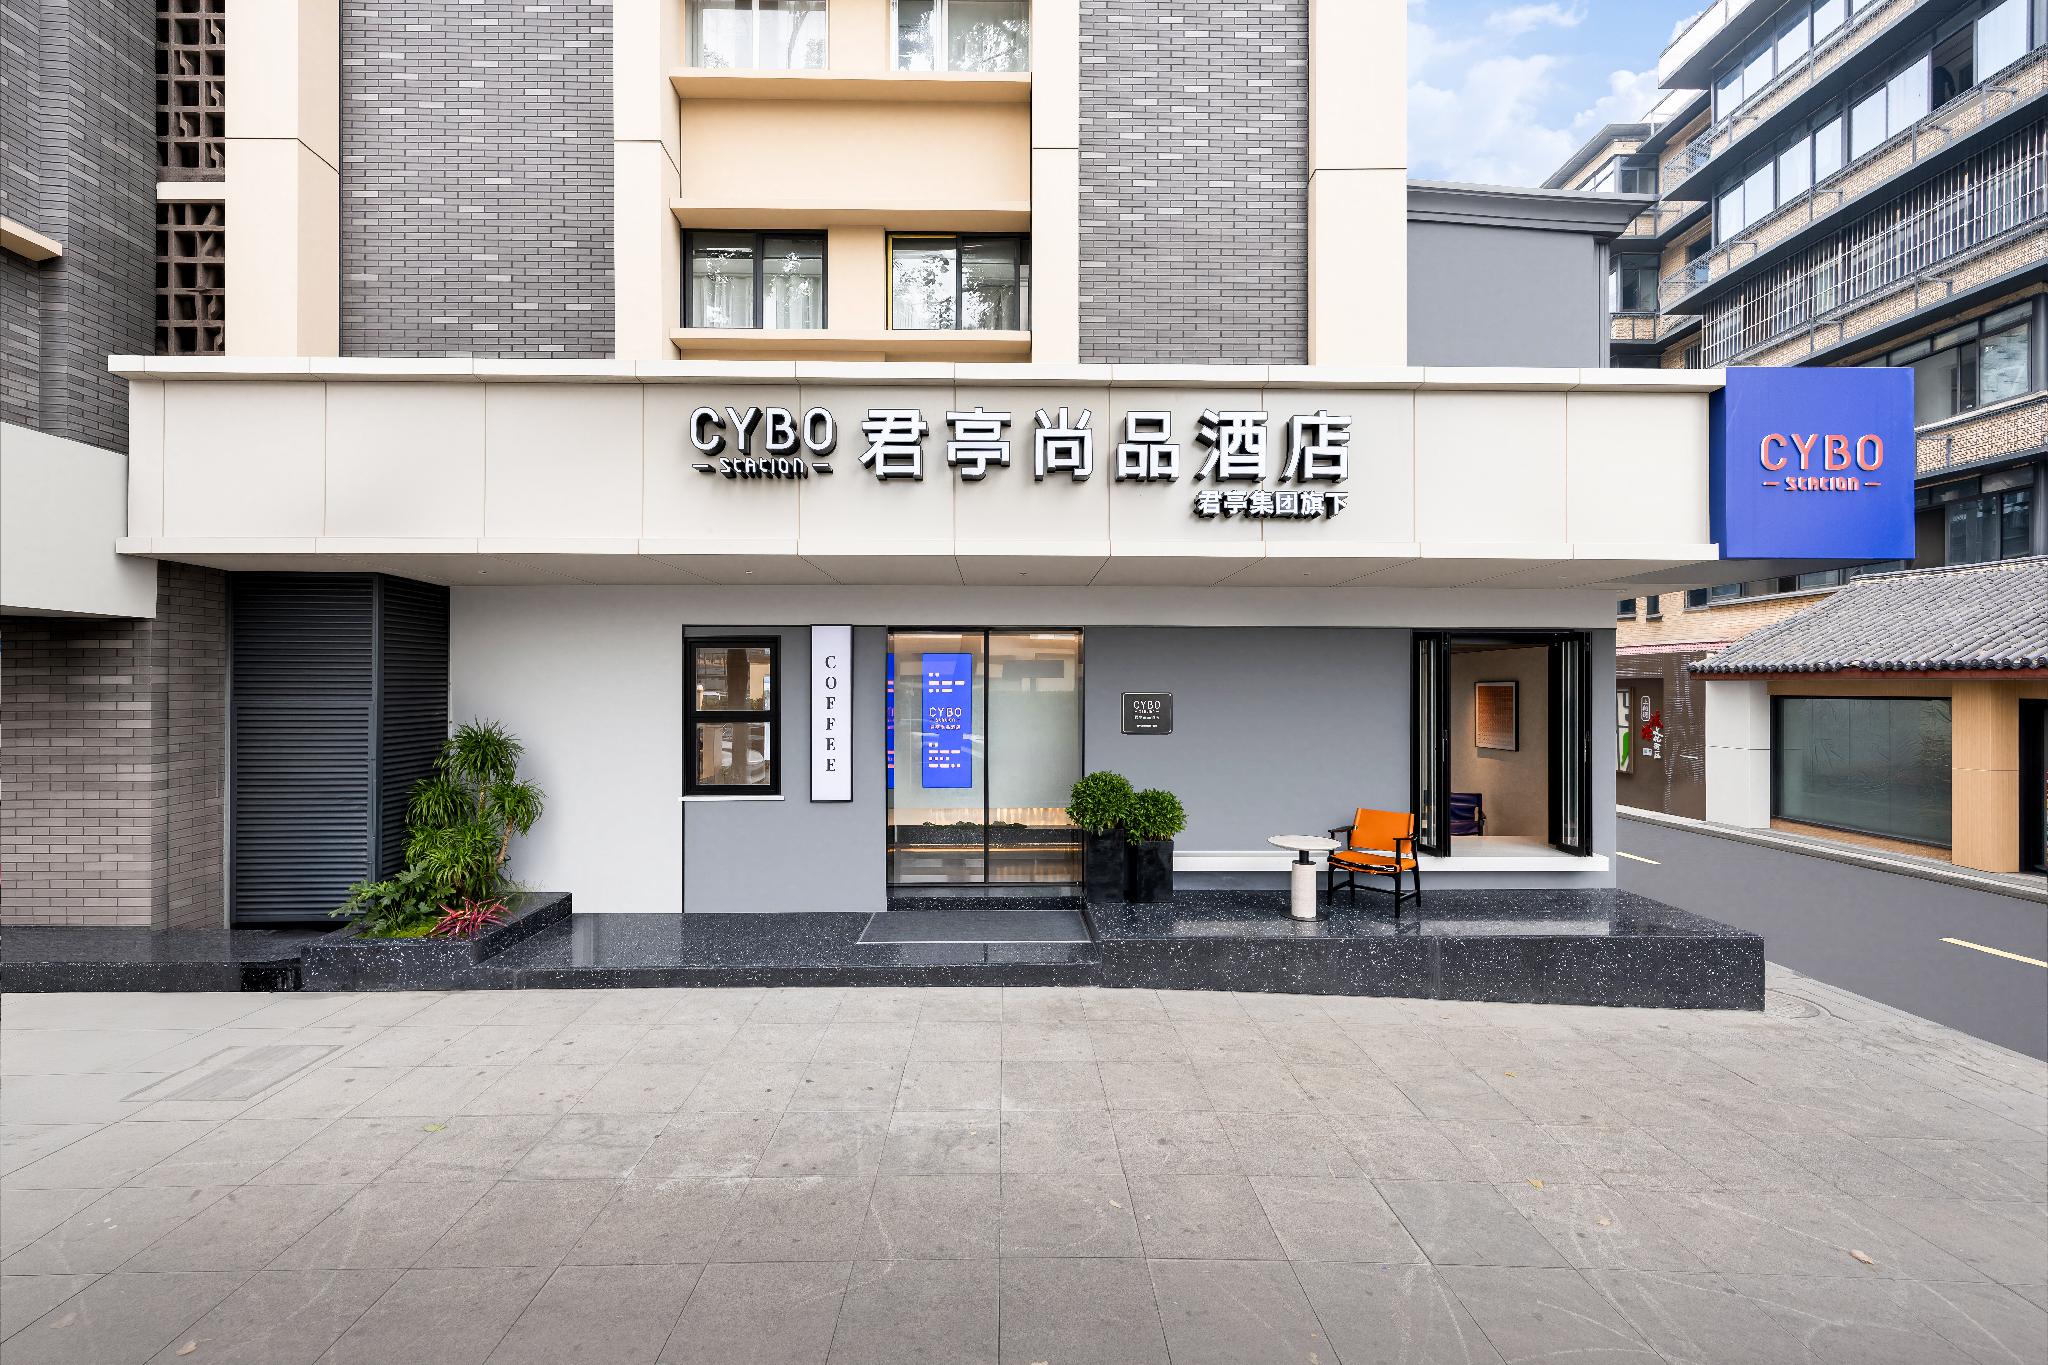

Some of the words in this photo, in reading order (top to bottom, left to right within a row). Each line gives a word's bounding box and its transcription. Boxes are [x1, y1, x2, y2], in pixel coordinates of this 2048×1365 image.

[690, 406, 837, 455] CYBO
[860, 407, 1352, 481] 君亭尚品酒店
[1760, 432, 1884, 471] CYBO
[1195, 490, 1349, 518] 君亭集团旗下
[825, 655, 837, 772] COFFEE
[929, 707, 962, 717] CYBO
[1133, 700, 1161, 710] CYBO
